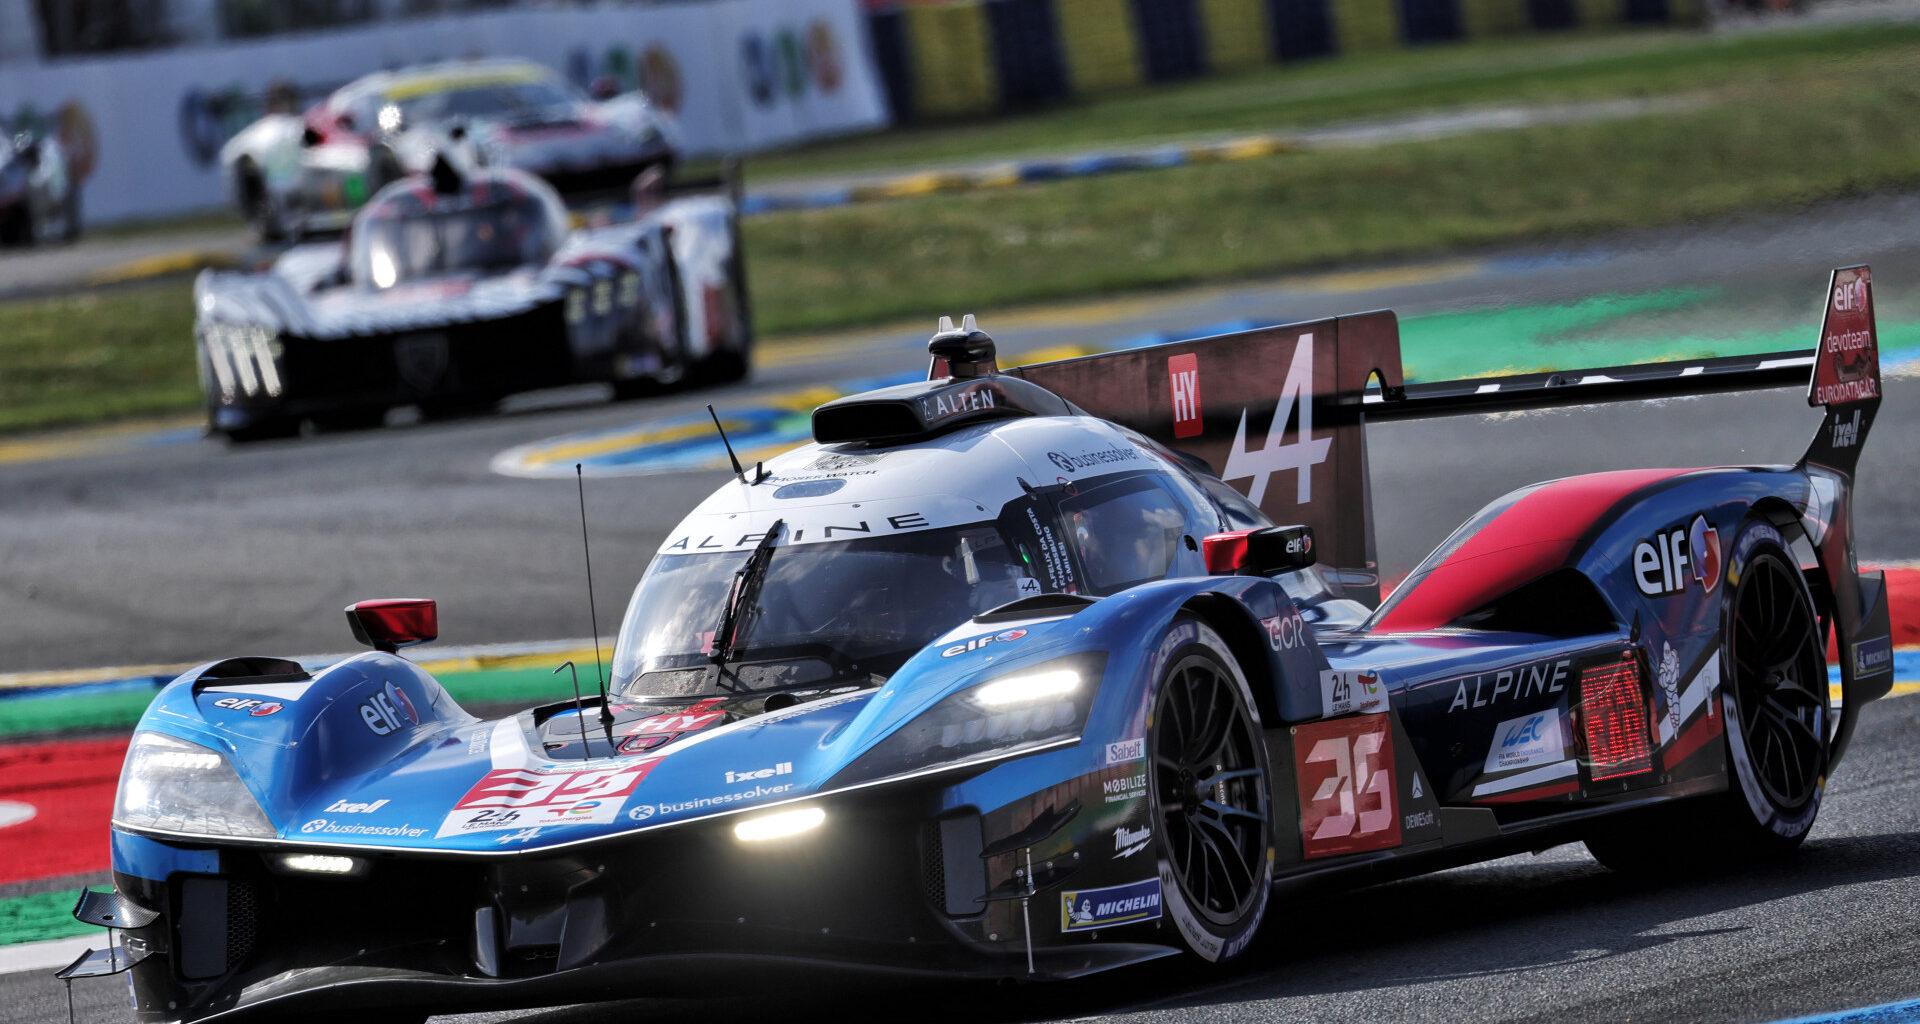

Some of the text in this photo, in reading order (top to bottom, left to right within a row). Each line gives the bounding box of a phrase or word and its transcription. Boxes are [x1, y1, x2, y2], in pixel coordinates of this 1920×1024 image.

[1834, 282, 1854, 311] elf
[1827, 330, 1871, 353] devoteam
[937, 389, 995, 415] ALTEN
[1172, 370, 1196, 422] HY
[1817, 379, 1876, 404] EURODATACAR
[1062, 442, 1139, 468] businessolver
[667, 512, 933, 551] ALPINE
[1026, 507, 1042, 536] COSTA
[1286, 538, 1303, 554] elf
[1633, 529, 1688, 595] elf
[942, 635, 994, 658] elf
[1269, 616, 1306, 651] GCR
[1448, 659, 1571, 714] ALPINE
[214, 697, 263, 711] elf
[361, 693, 402, 736] elf
[629, 710, 717, 733] HY
[1501, 715, 1545, 749] WEC
[1110, 741, 1142, 761] Sabelt
[725, 761, 793, 784] ixell
[1305, 731, 1393, 840] 35
[457, 769, 644, 807] 35
[660, 782, 794, 815] businessolver
[323, 798, 391, 813] ixell
[322, 820, 430, 838] businessolver
[1405, 812, 1434, 830] DEWESoft
[1112, 824, 1151, 851] Milwaukee
[1096, 893, 1160, 917] MICHELIN
